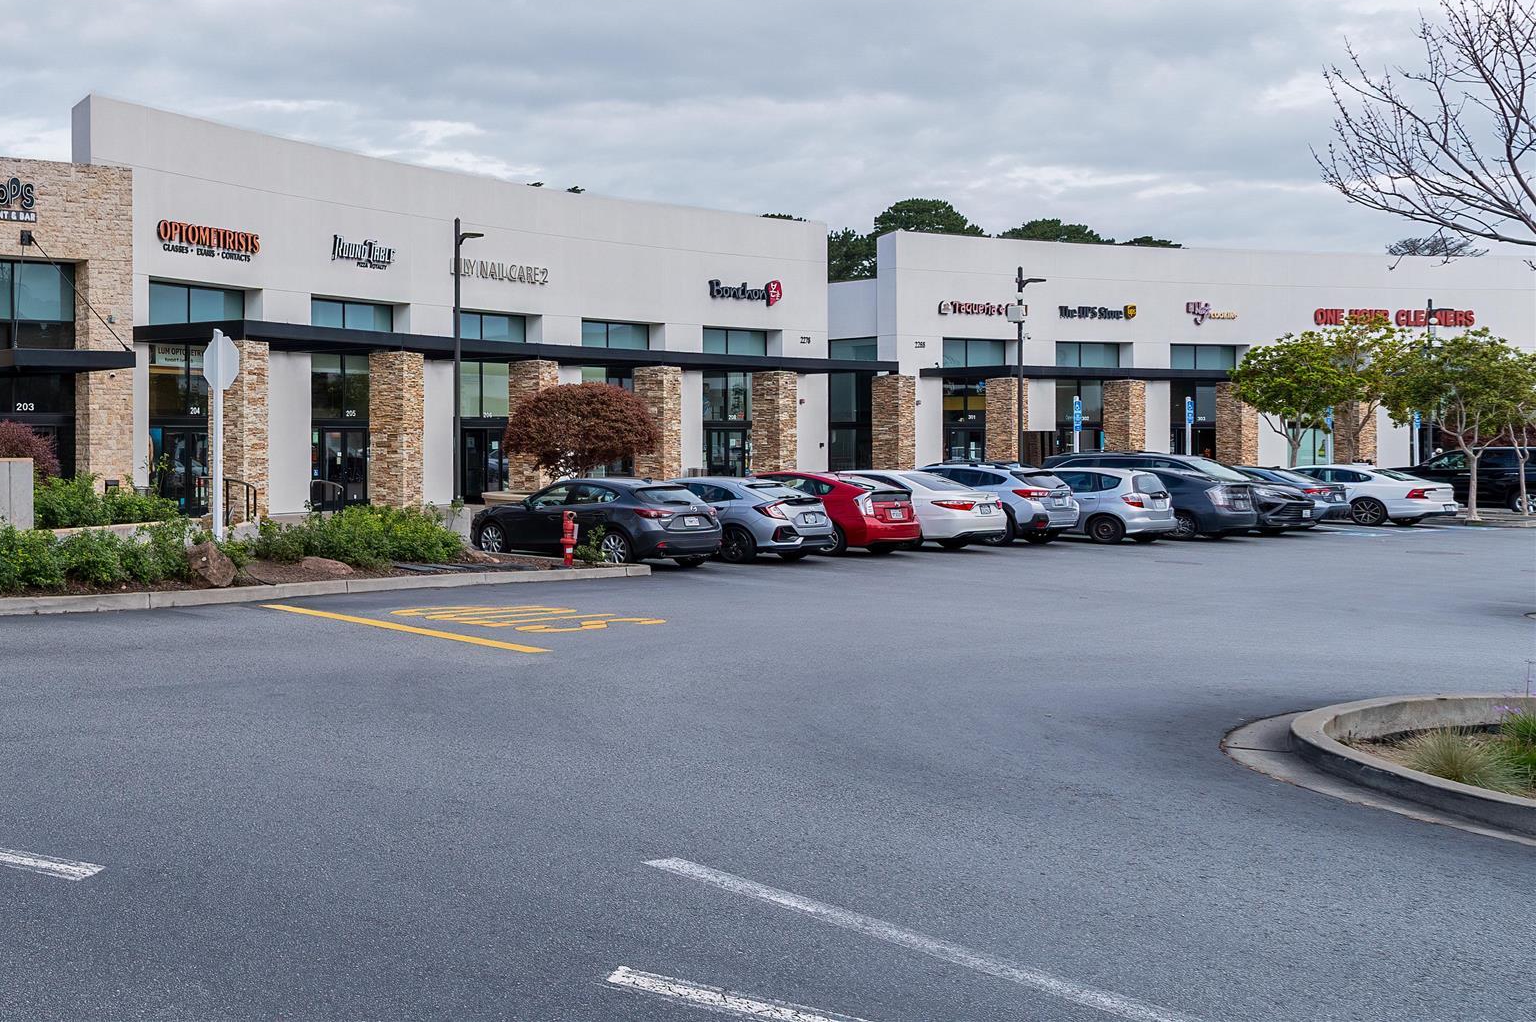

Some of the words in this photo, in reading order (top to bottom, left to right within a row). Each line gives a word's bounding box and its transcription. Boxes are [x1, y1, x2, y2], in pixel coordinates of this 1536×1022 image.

[11, 211, 17, 220] &
[19, 211, 36, 221] BAR
[157, 219, 260, 254] OPTOMETRISTS
[331, 234, 368, 261] ROUND
[363, 239, 396, 265] TABLE
[221, 252, 251, 262] CONTACTS
[450, 258, 476, 277] LLY
[476, 261, 506, 281] NAIL
[507, 264, 540, 284] CARE
[539, 268, 549, 285] 2
[708, 279, 767, 299] Bonchon
[951, 301, 996, 316] Taqueria
[1058, 306, 1077, 319] The
[1078, 306, 1097, 319] UPS
[1098, 306, 1123, 320] Store
[1314, 308, 1345, 325] ONE
[171, 348, 203, 357] OPTOETR
[16, 402, 35, 411] 203
[190, 406, 200, 415] 204
